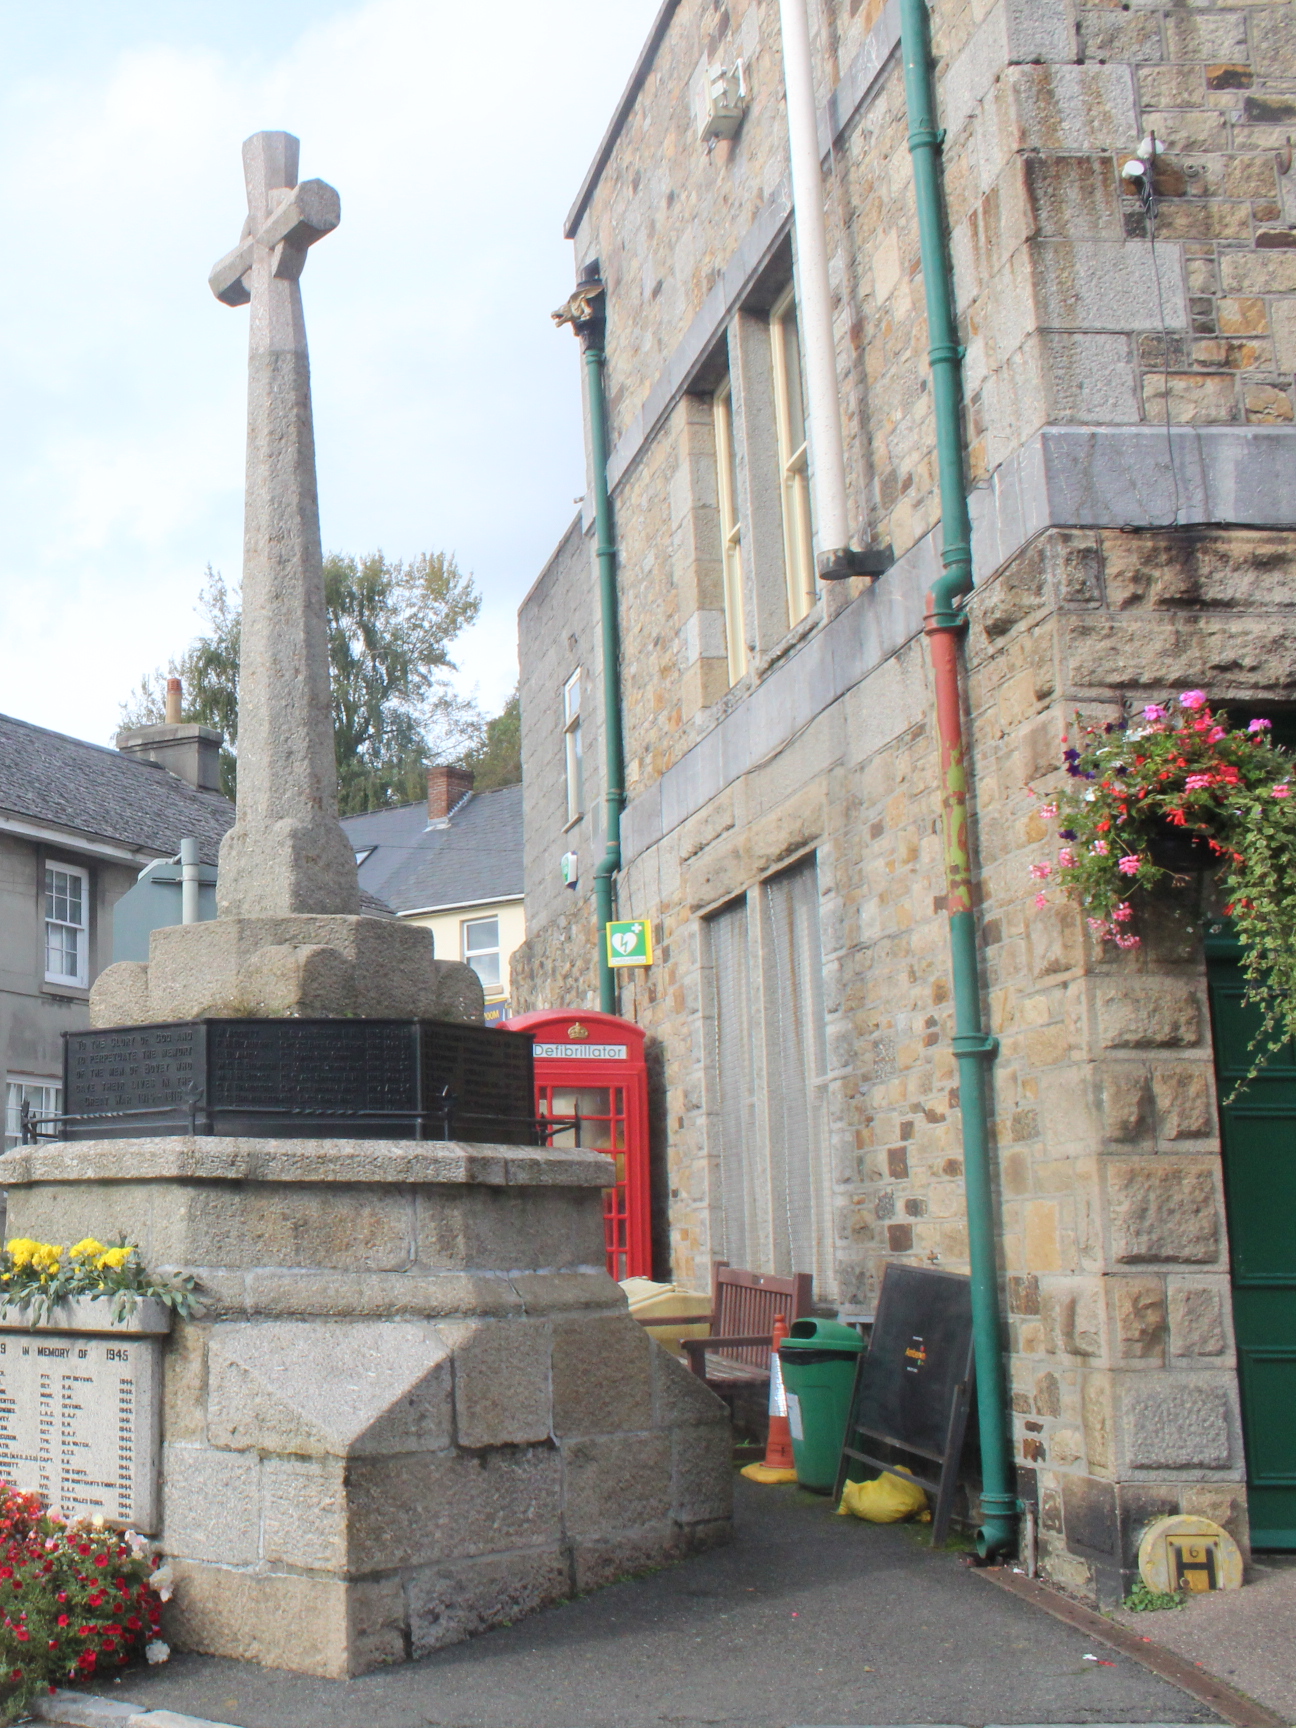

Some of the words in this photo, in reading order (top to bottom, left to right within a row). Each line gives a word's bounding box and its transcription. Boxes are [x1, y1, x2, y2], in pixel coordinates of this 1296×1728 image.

[91, 1039, 106, 1049] THE
[111, 1037, 136, 1048] GLORY
[140, 1036, 149, 1046] OF
[156, 1032, 172, 1044] GOD
[176, 1030, 192, 1042] AND
[90, 1050, 137, 1064] PERPETUATE
[143, 1049, 156, 1060] THE
[162, 1046, 192, 1058] MEMORY
[534, 1044, 622, 1058] Defibrillator
[76, 1069, 85, 1079] OF
[91, 1068, 104, 1078] THE
[109, 1067, 124, 1077] MEN
[130, 1065, 139, 1076] OF
[176, 1062, 192, 1072] WHO
[76, 1084, 95, 1093] GAVE
[102, 1082, 125, 1091] THEIR
[132, 1078, 155, 1090] LIVES
[162, 1078, 170, 1087] IN
[22, 1346, 29, 1356] IN
[37, 1346, 70, 1358] MEMORY
[78, 1349, 88, 1359] OF
[106, 1349, 128, 1362] 1945
[1175, 1547, 1217, 1590] H
